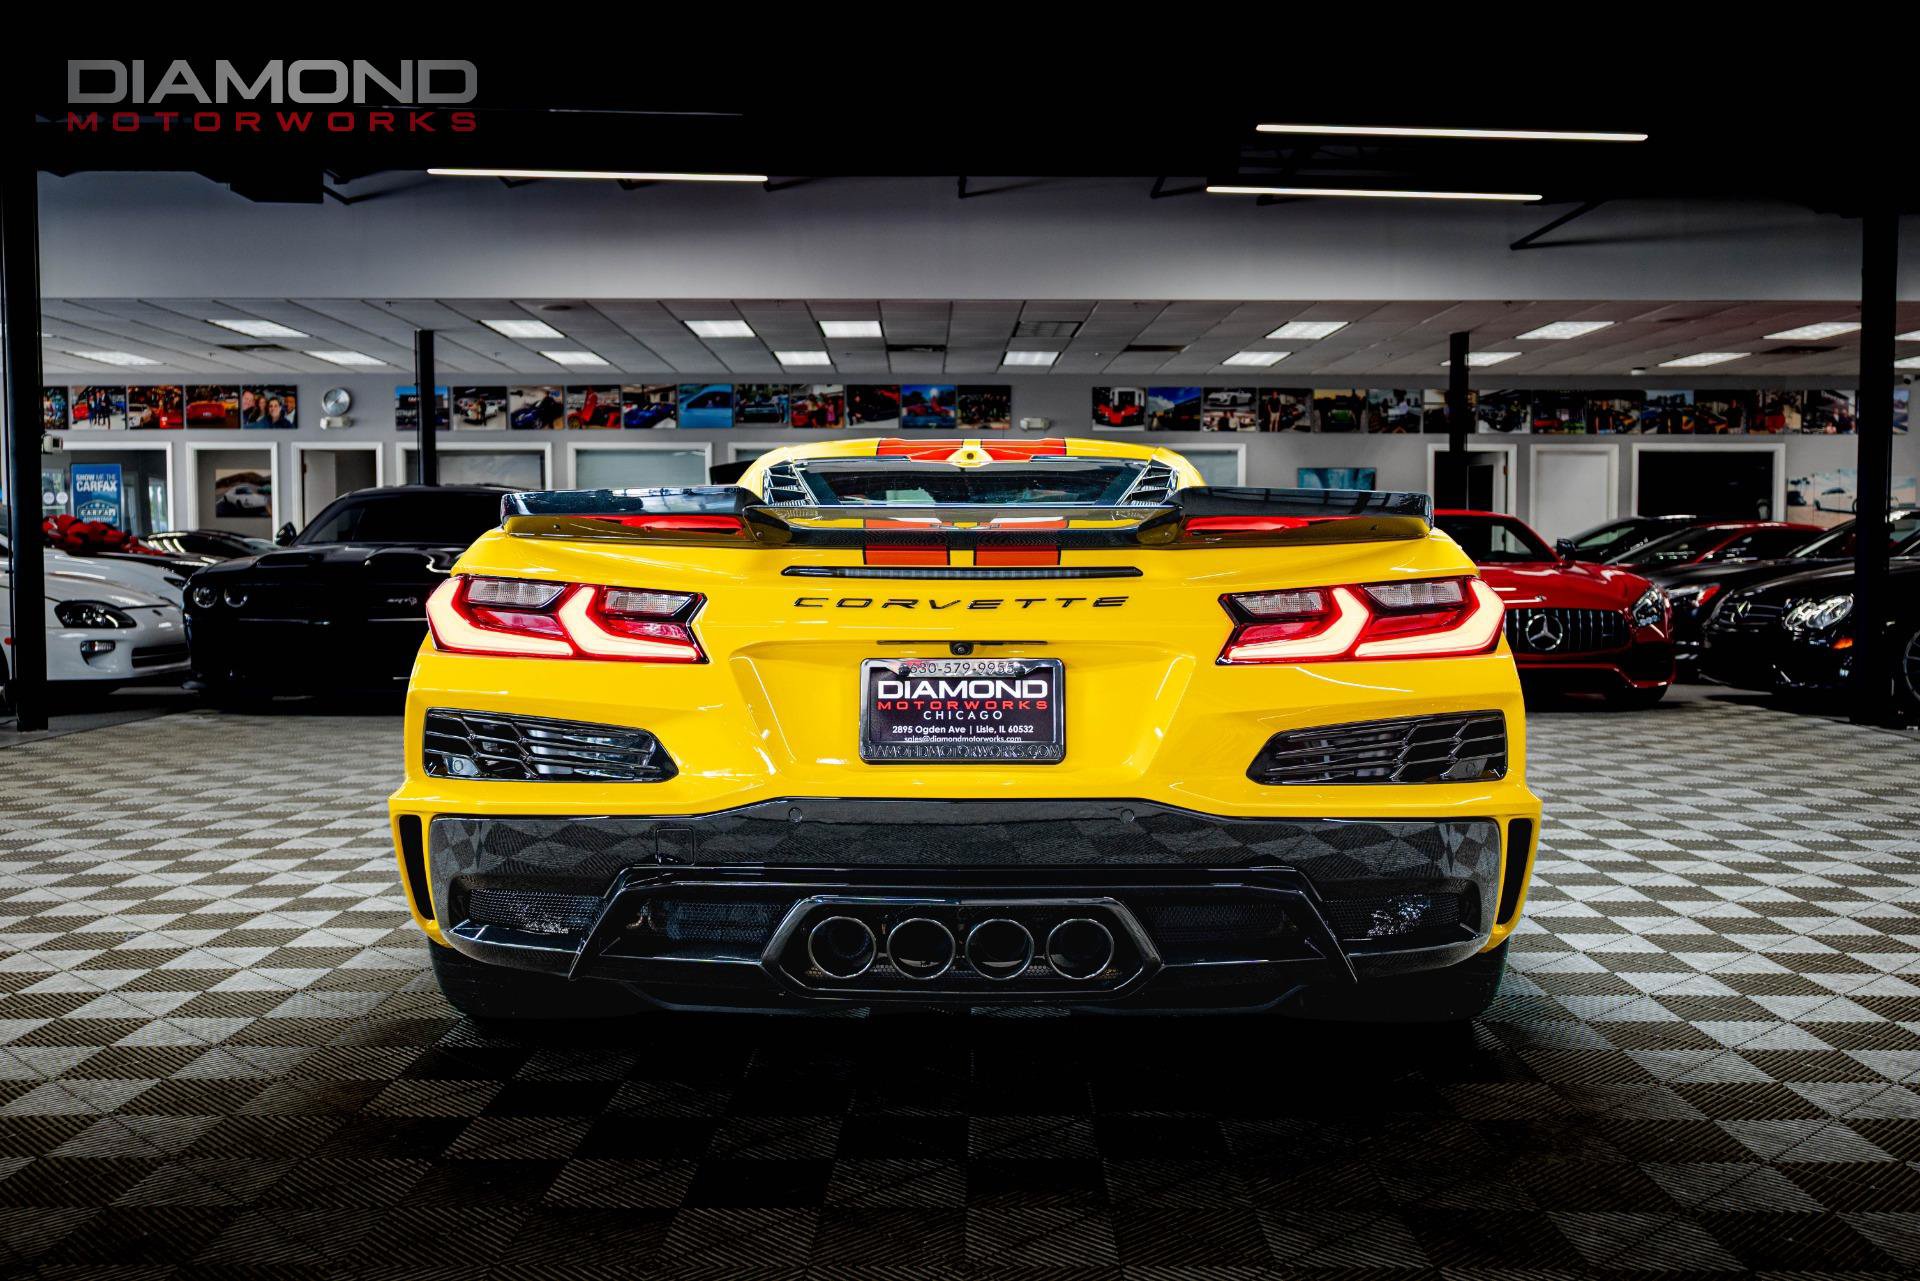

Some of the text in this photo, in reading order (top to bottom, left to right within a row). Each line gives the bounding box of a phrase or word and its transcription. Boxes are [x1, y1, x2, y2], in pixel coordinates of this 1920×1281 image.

[76, 473, 95, 481] SHOW
[76, 481, 117, 492] CARFAX
[793, 596, 1129, 610] CORVETTE
[910, 662, 1015, 674] 630-579-9955
[878, 680, 1048, 699] DIAMOND
[877, 700, 1048, 710] MOTORWORKS
[923, 710, 1003, 720] CHICAGO
[892, 725, 913, 734] 2895
[915, 725, 946, 736] Ogden
[948, 725, 966, 734] Ave
[976, 725, 997, 735] Lisle,
[999, 725, 1006, 733] IL
[1008, 725, 1034, 734] 60532
[904, 735, 1022, 743] sales@diamondmotorworks.com
